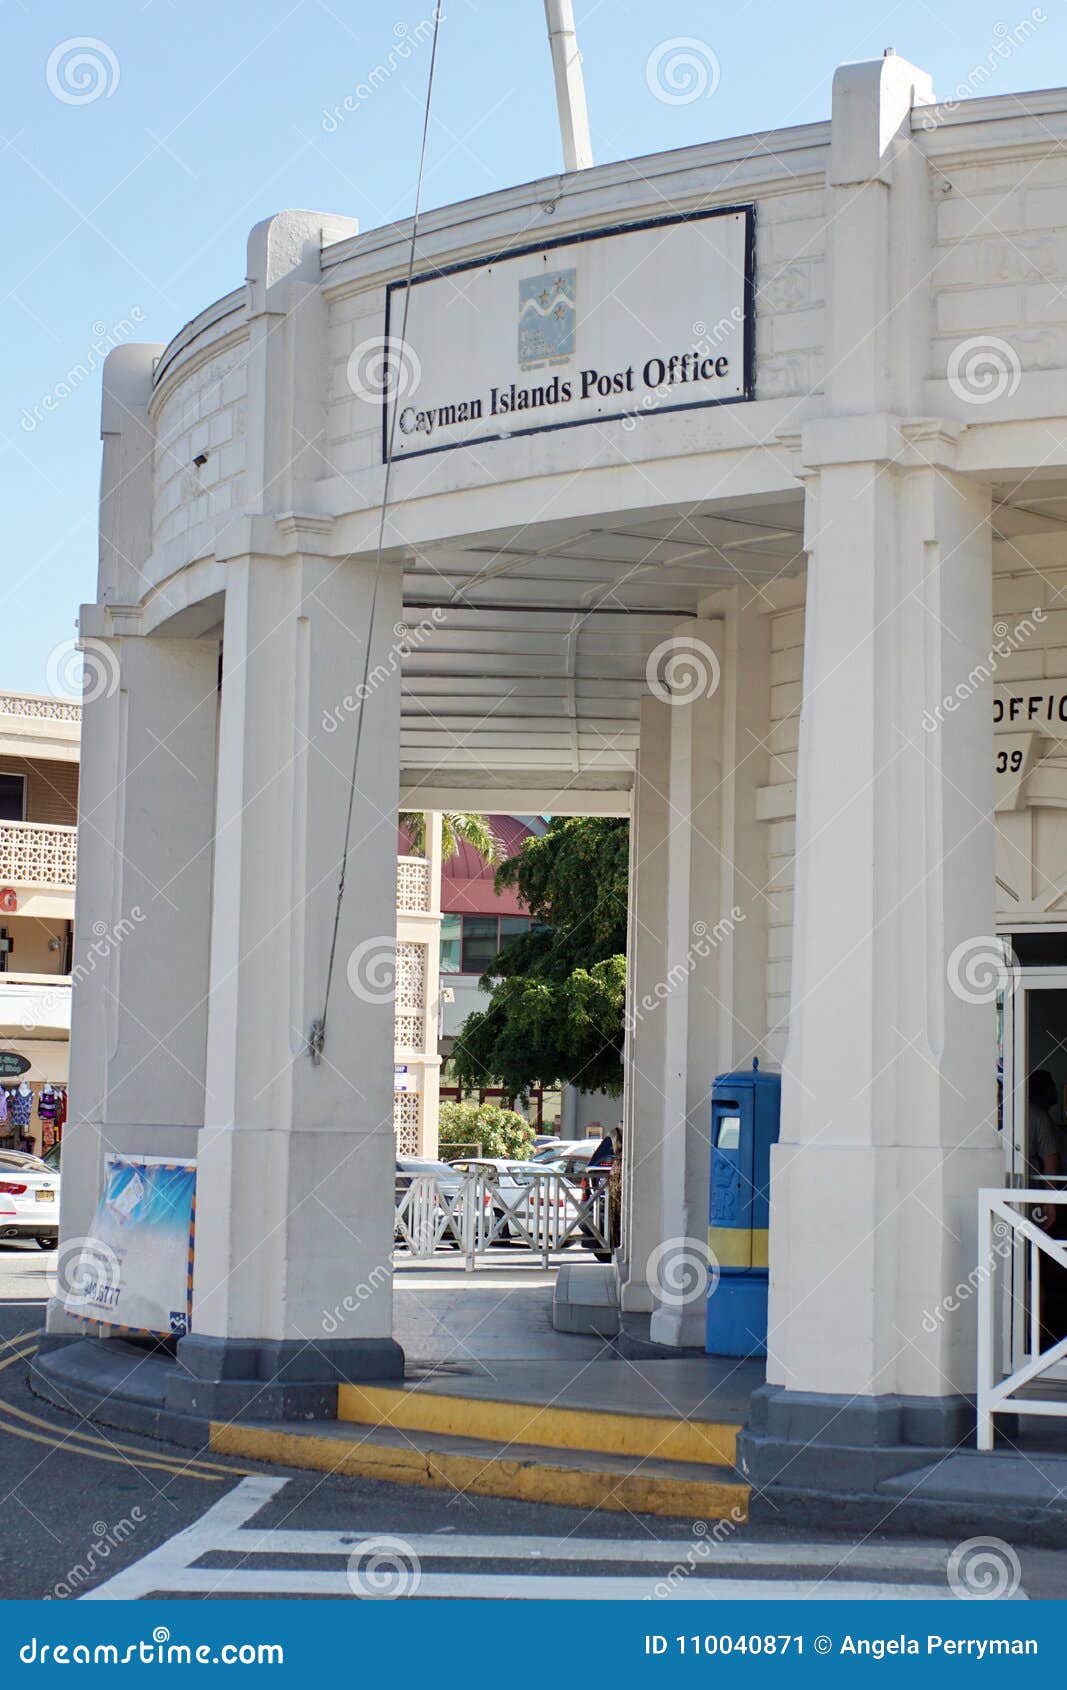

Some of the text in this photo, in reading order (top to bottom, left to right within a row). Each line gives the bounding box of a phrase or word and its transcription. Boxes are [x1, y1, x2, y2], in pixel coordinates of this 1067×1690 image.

[400, 352, 729, 435] Cayman Islands Post Office
[996, 751, 1022, 773] 39
